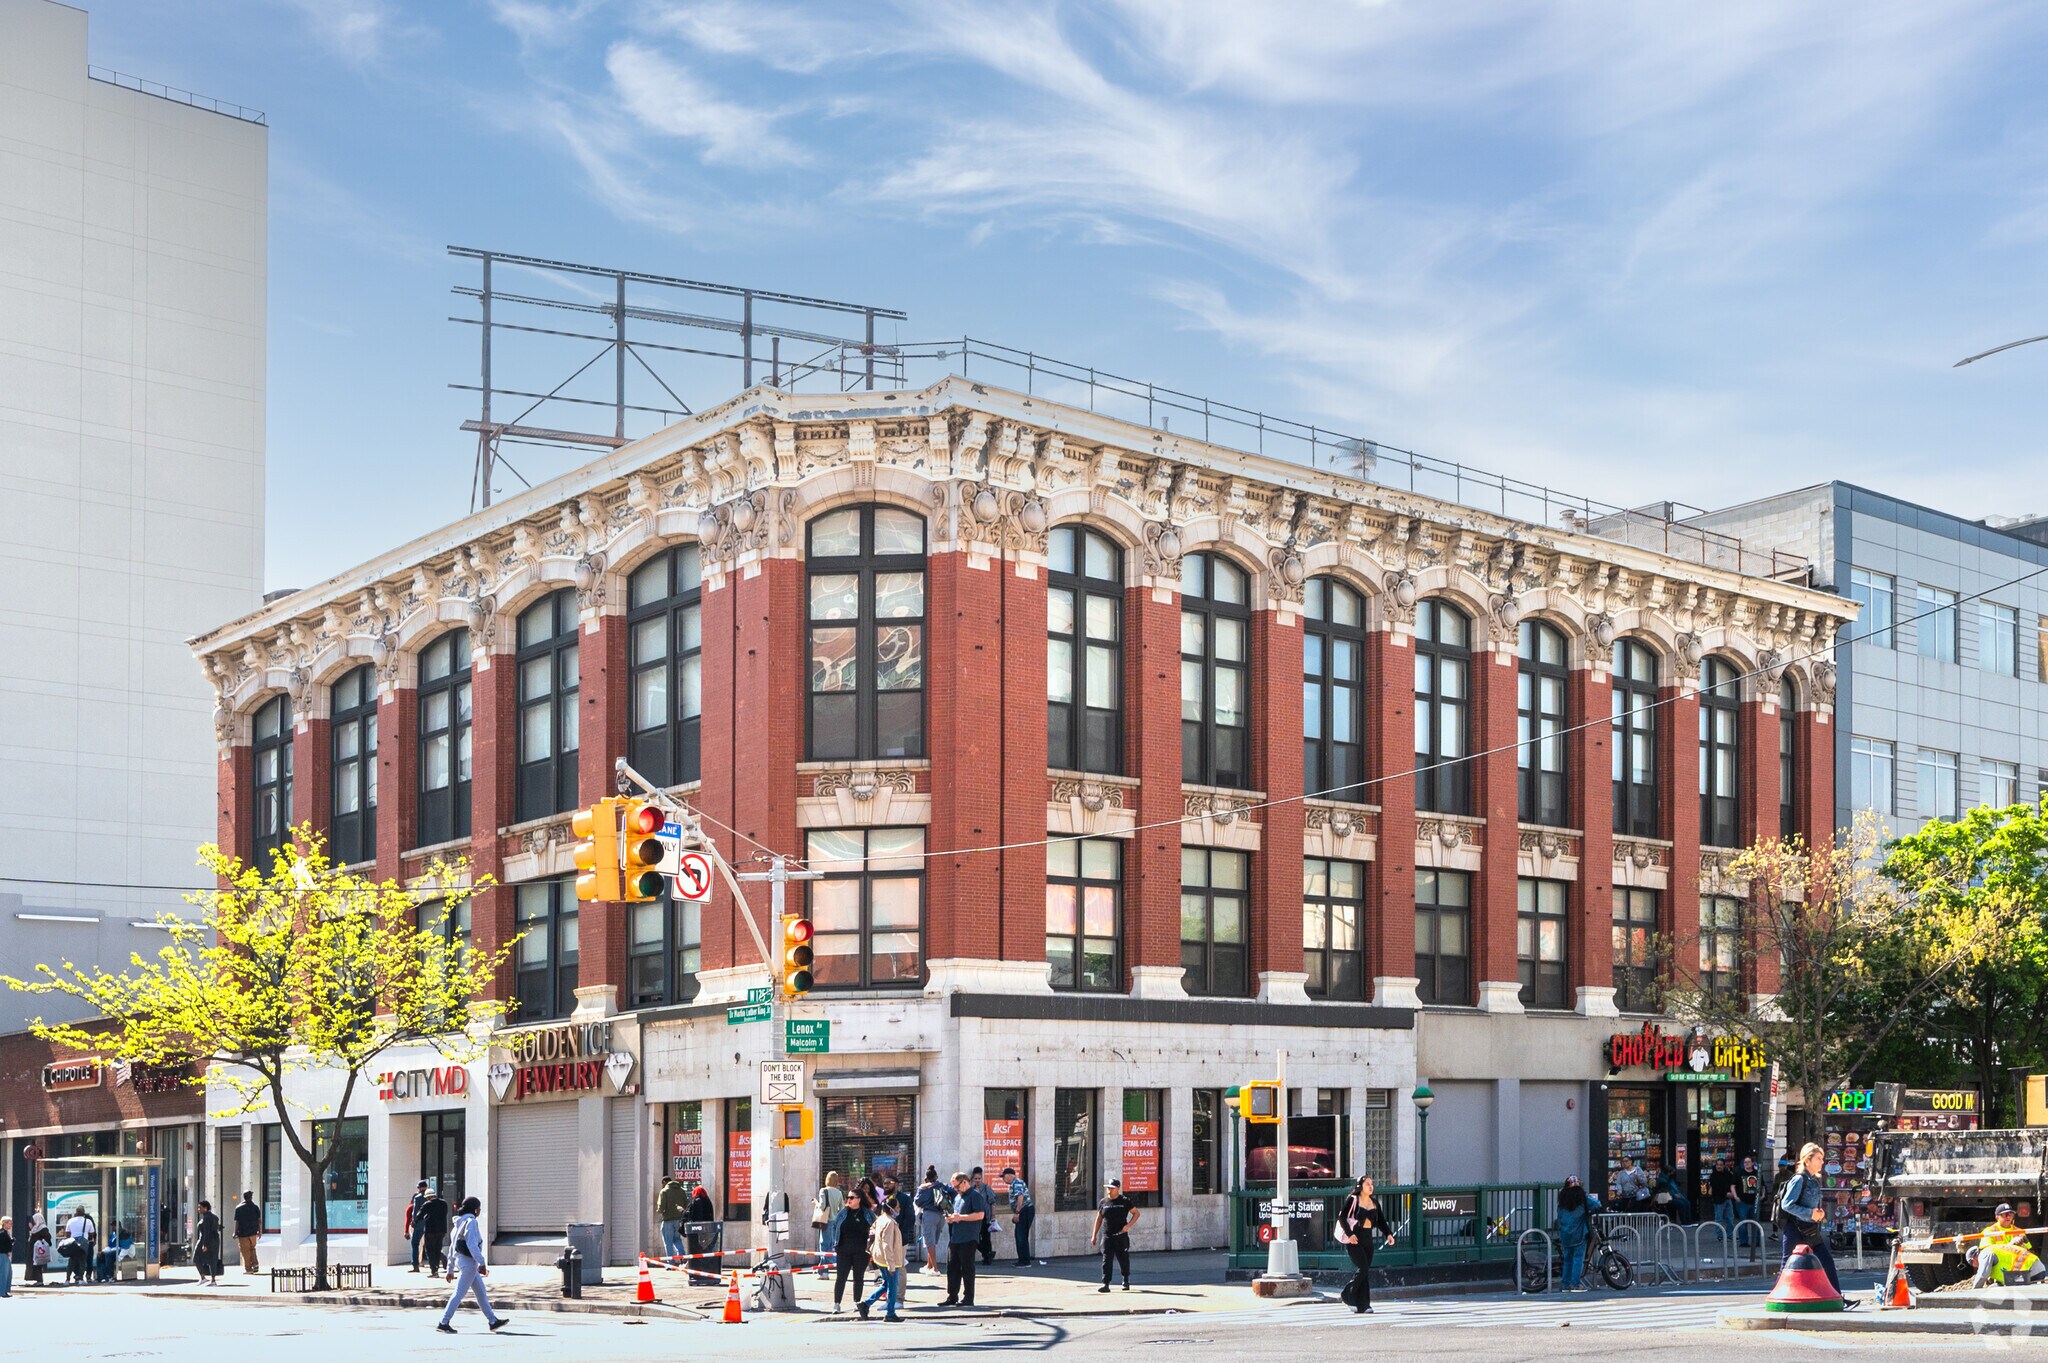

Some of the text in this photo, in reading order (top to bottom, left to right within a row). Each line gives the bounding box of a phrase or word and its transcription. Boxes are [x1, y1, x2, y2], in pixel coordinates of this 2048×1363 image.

[661, 825, 678, 836] ANE
[661, 841, 677, 852] NLY
[757, 1006, 766, 1017] King
[791, 1021, 815, 1035] Lenox
[510, 1021, 611, 1063] GOLDEN ICE
[790, 1037, 824, 1047] Malcolm X
[1612, 1021, 1767, 1080] CHOPPED CHEESE
[763, 1064, 802, 1073] DON'T BLOCK
[49, 1065, 91, 1085] CHIPOTLE
[514, 1060, 605, 1100] JEWELRY
[770, 1073, 796, 1081] THE BOX
[393, 1065, 468, 1099] CITYMD
[1932, 1093, 1964, 1110] GOOD
[1002, 1139, 1022, 1147] SPACE
[730, 1150, 745, 1158] RETAIL
[985, 1149, 1018, 1157] FOR LEASE
[1124, 1149, 1153, 1157] FOR LEASE
[356, 1160, 368, 1173] JU
[674, 1157, 688, 1170] FOR
[732, 1160, 742, 1168] FOR
[356, 1184, 365, 1196] IN
[1259, 1202, 1271, 1212] 125
[1297, 1201, 1324, 1212] Station
[1422, 1197, 1457, 1212] Subway
[1258, 1211, 1271, 1220] Upto
[1296, 1211, 1312, 1219] Bronx
[1262, 1227, 1270, 1240] 2
